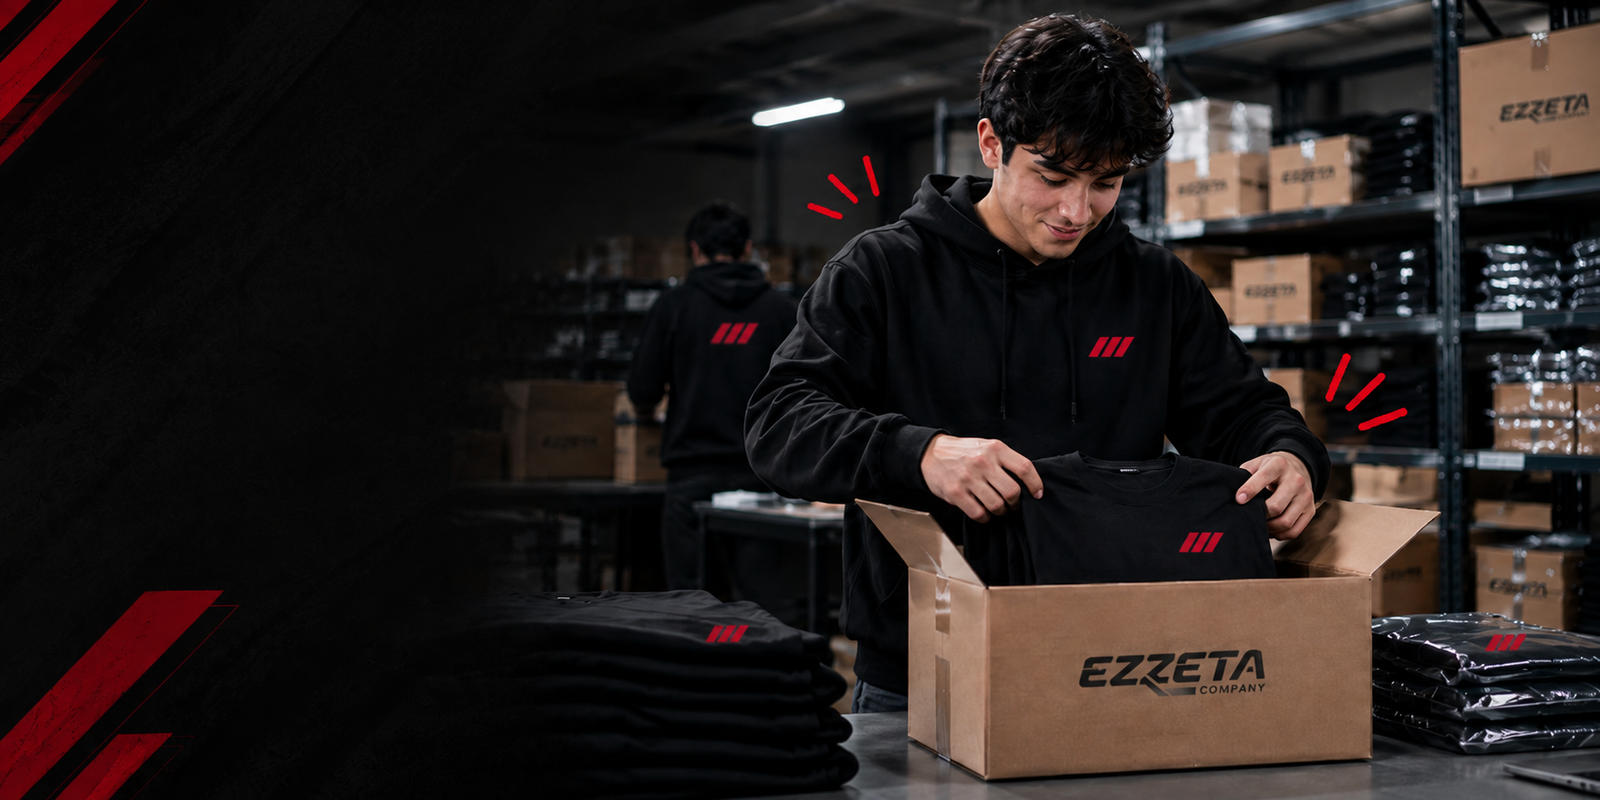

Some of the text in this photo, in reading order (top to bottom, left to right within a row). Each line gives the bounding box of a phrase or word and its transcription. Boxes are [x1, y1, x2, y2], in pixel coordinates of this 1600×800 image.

[1500, 92, 1589, 123] EZZETA
[1079, 649, 1265, 697] EZZETA
[1200, 683, 1265, 695] COMPANY
